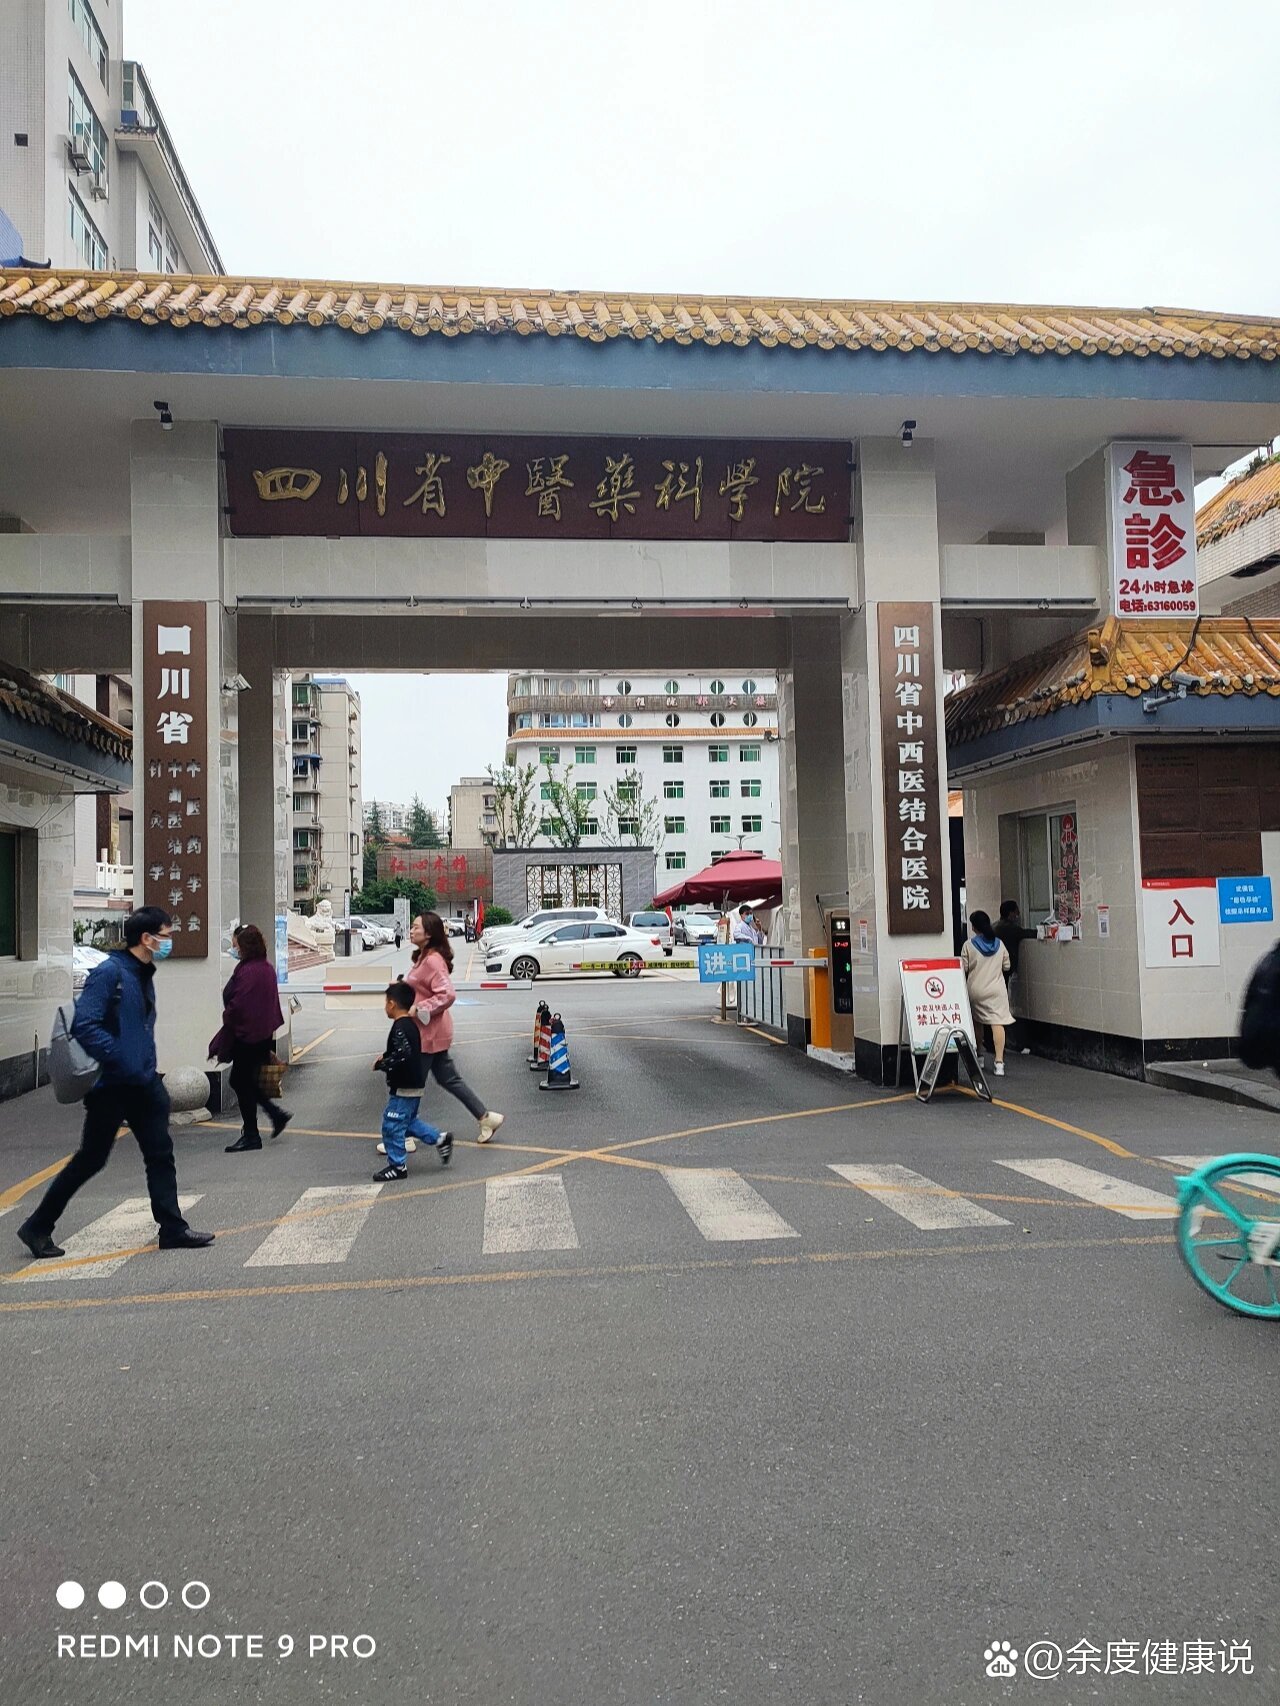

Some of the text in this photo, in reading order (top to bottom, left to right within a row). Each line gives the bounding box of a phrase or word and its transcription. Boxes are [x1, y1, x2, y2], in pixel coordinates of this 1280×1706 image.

[1123, 450, 1187, 571] 急診
[1119, 579, 1194, 596] 24小时急诊
[1119, 599, 1196, 613] 电话:63160059
[893, 625, 930, 910] 四川省中西医结合医院
[1168, 898, 1195, 958] 入口
[704, 952, 750, 975] 进口
[917, 1012, 962, 1026] 禁止入内
